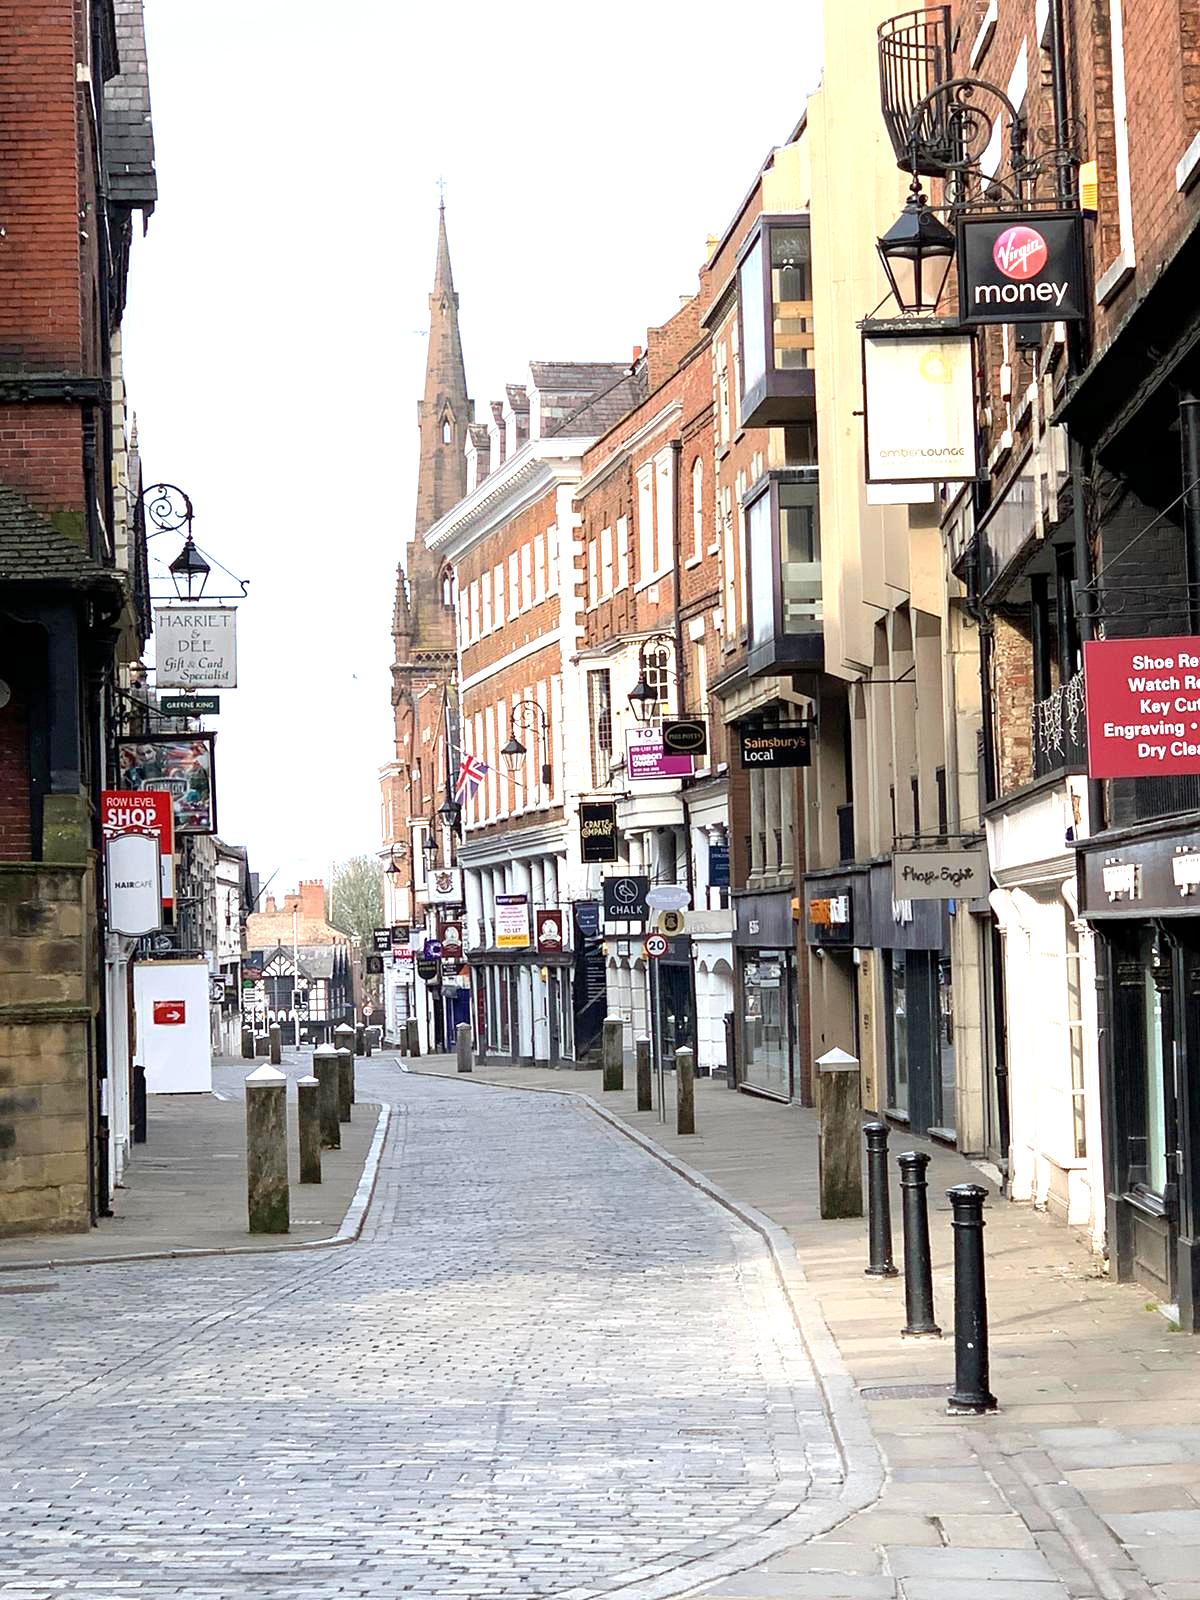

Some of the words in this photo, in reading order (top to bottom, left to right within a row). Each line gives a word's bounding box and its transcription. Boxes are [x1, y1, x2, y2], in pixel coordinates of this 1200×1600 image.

[997, 231, 1045, 272] Virgin
[974, 281, 1069, 307] money
[160, 615, 230, 627] HARRIET
[191, 629, 200, 639] &
[178, 640, 215, 652] DEE
[164, 656, 184, 672] Gift
[198, 657, 223, 669] Card
[1132, 655, 1174, 670] Shoe
[1178, 653, 1200, 668] Re
[180, 668, 229, 683] Specialist
[1127, 676, 1180, 692] Watch
[166, 701, 194, 709] GREENE
[196, 701, 214, 709] KING
[1140, 699, 1170, 716] Key
[635, 729, 653, 738] TO
[1103, 720, 1185, 739] Engraving
[744, 737, 806, 749] Sainsbury's
[744, 748, 774, 761] Local
[1138, 743, 1166, 760] Dry
[106, 797, 128, 807] ROW
[129, 797, 157, 807] LEVEL
[107, 808, 157, 825] SHOP
[940, 866, 974, 888] Eight
[609, 905, 643, 915] CHALK
[648, 940, 665, 951] 20
